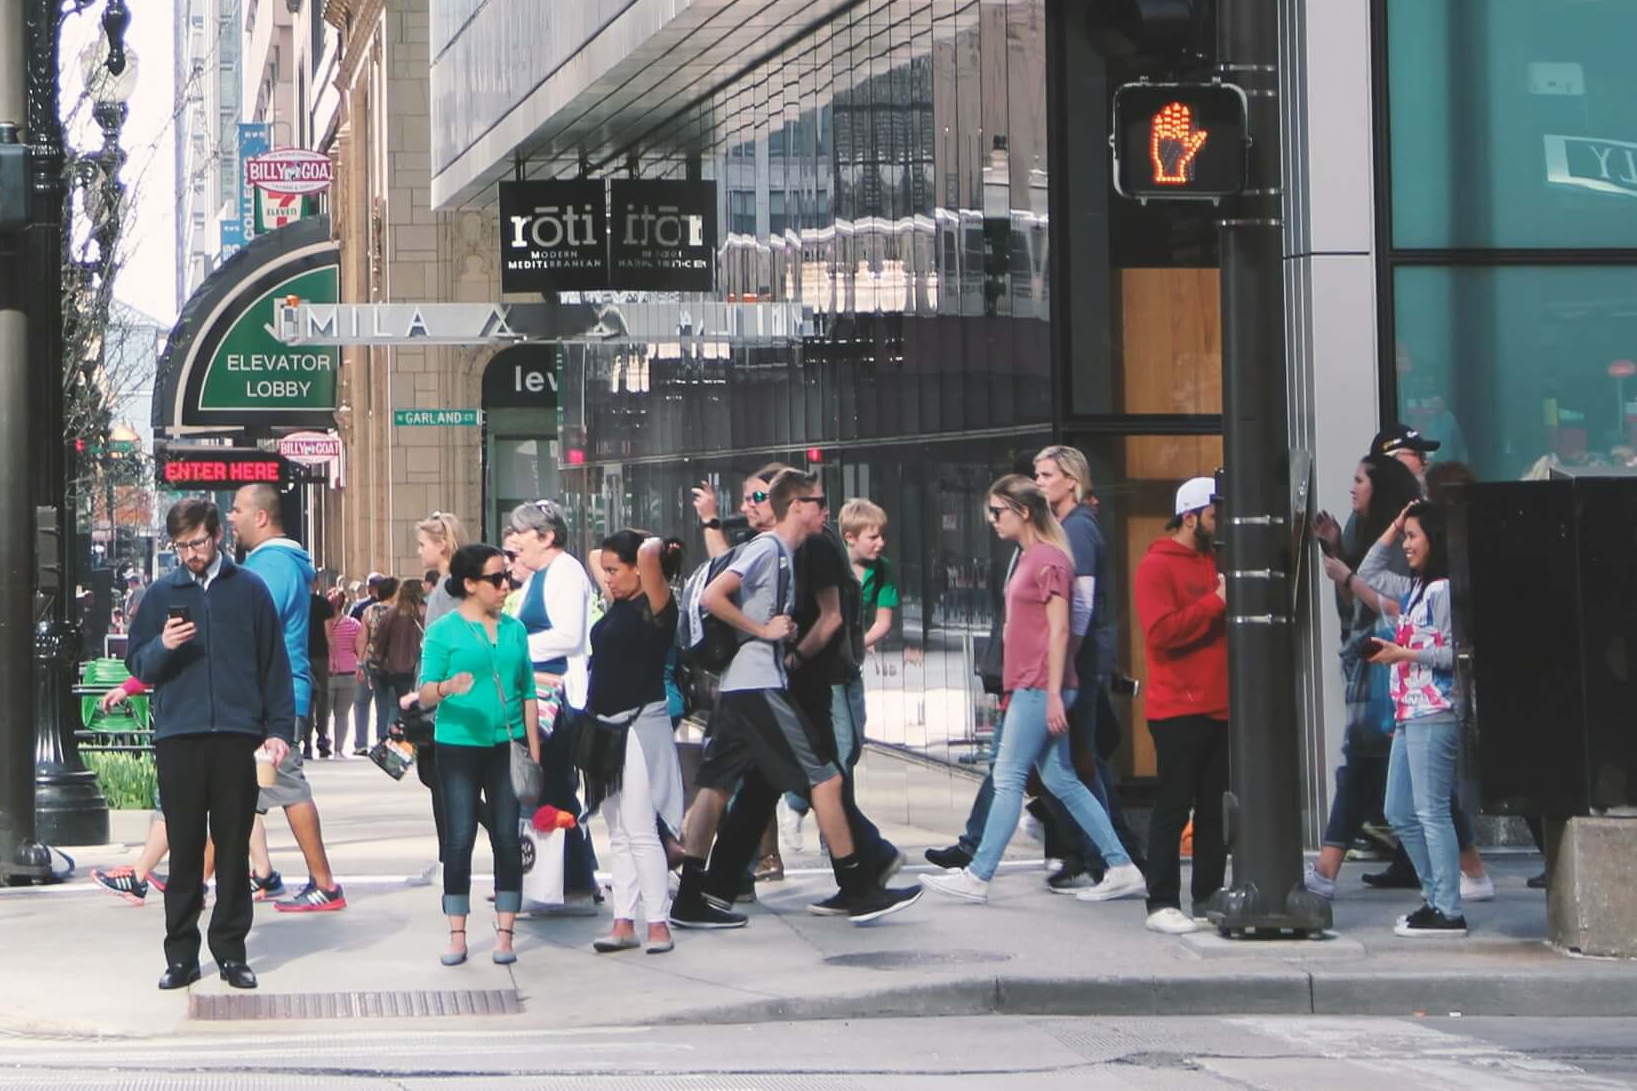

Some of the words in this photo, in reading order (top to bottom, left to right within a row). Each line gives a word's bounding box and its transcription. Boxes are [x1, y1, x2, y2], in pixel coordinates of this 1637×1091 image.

[250, 162, 286, 180] BILLY
[531, 250, 578, 259] MODERN
[227, 354, 331, 371] ELEVATOR
[246, 380, 312, 398] LOBBY
[405, 412, 462, 425] GARLAND
[280, 441, 306, 455] BILLY
[316, 441, 339, 455] GOAT
[165, 461, 226, 481] ENTER
[229, 461, 280, 481] HERE
